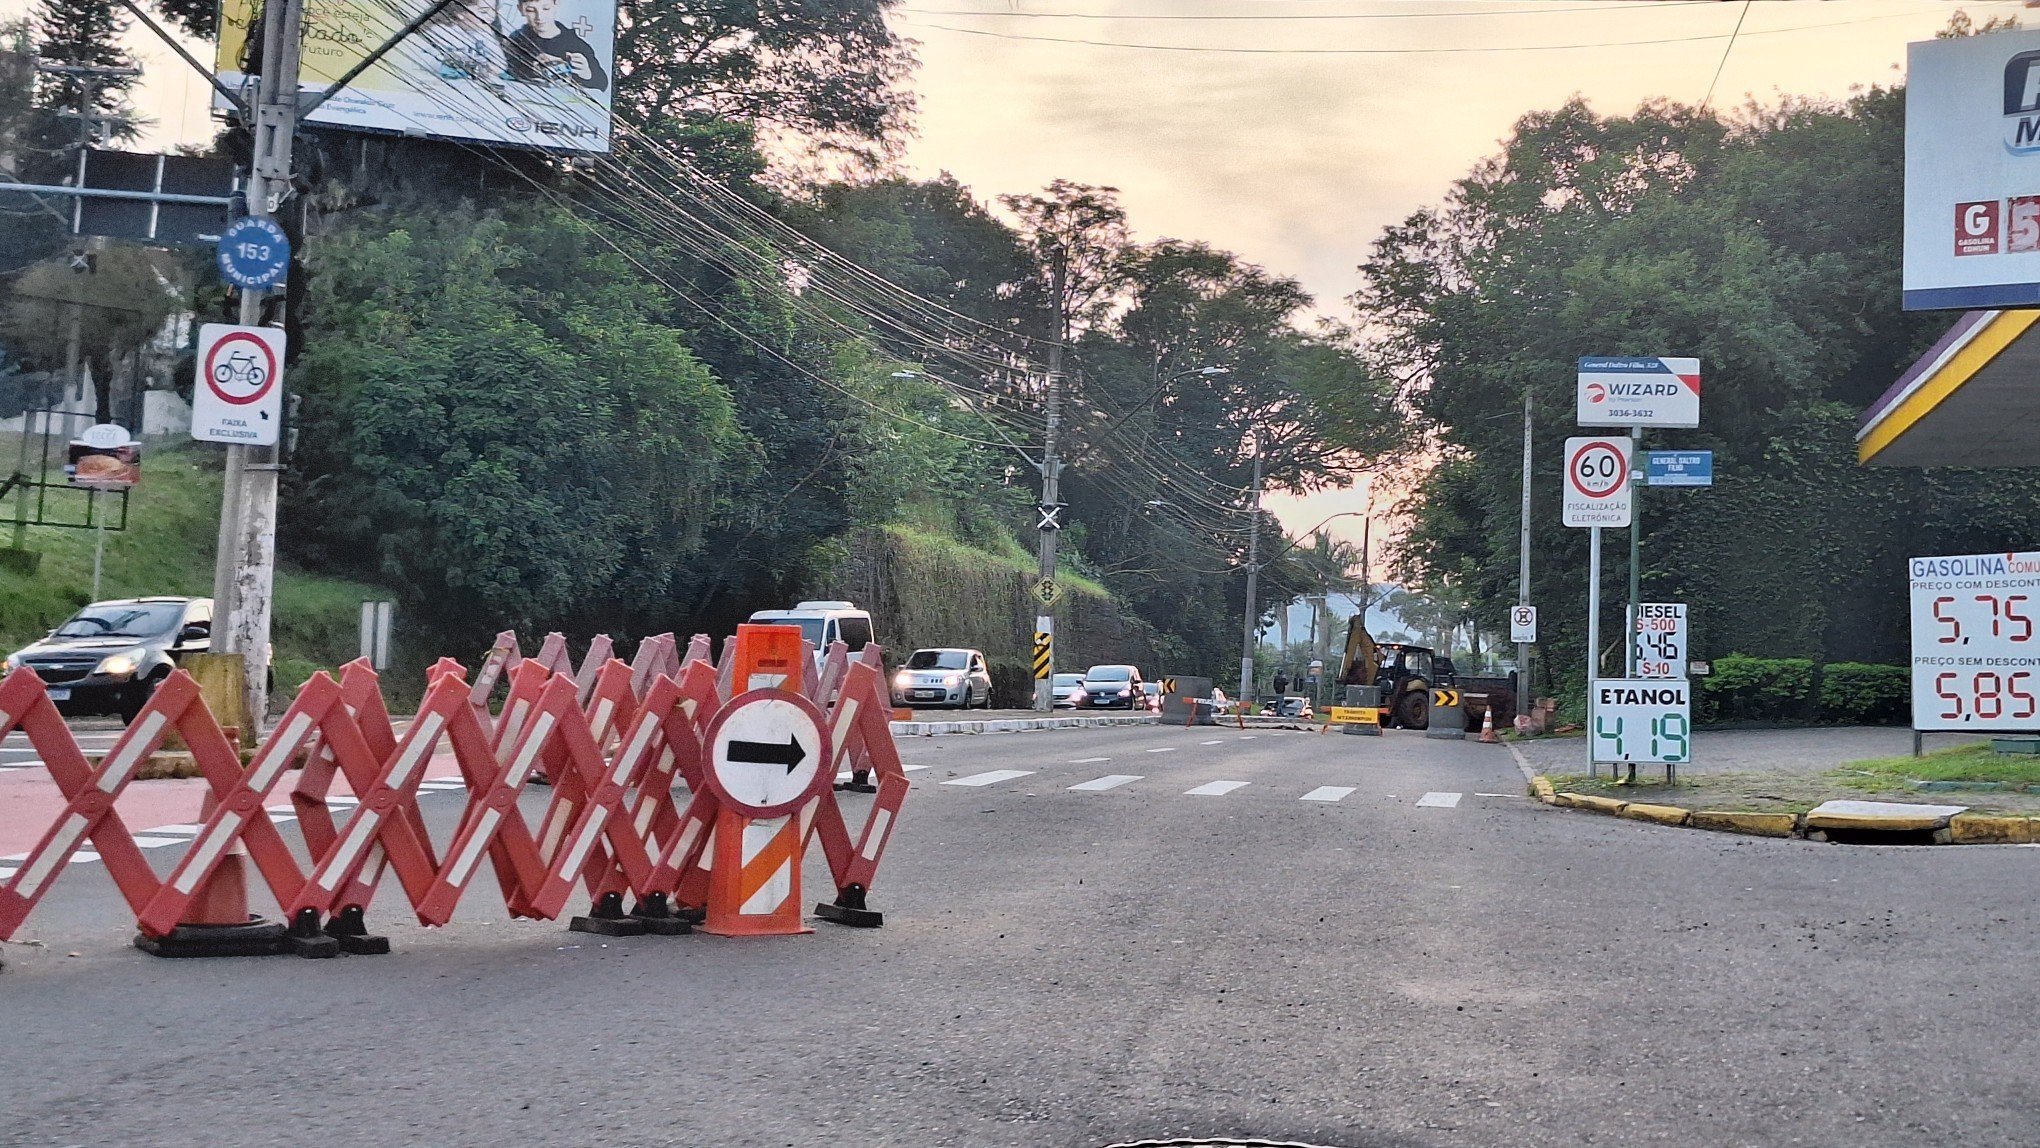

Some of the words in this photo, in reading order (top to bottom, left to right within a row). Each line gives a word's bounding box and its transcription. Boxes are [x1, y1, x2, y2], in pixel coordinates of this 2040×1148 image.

[1964, 204, 1990, 236] G
[229, 219, 283, 244] GUARDA
[1957, 237, 1995, 246] GASOLINA
[237, 242, 271, 261] 153
[1962, 245, 1990, 253] COMUM
[221, 253, 285, 285] MUNICIPAL
[1608, 383, 1678, 396] WIZARD
[221, 418, 248, 428] FAIXA
[209, 428, 258, 439] EXCLUSIVA
[1580, 455, 1615, 478] 60
[1567, 502, 1627, 512] FISCALIZAÇÃO
[1571, 513, 1622, 522] ELETRÔNICA
[1912, 558, 2005, 578] GASOLINA
[1912, 582, 1952, 591] PREÇO
[1956, 581, 1982, 589] COM
[1638, 606, 1682, 618] IESEL
[1636, 619, 1676, 631] S-500
[1933, 595, 2032, 645] 5,75
[1914, 656, 1955, 667] PREÇO
[1958, 656, 1983, 666] SEM
[1642, 662, 1670, 674] S-10
[1601, 689, 1686, 705] ETANOL
[1936, 672, 2035, 722] 5,85
[1597, 713, 1688, 761] 4,19
